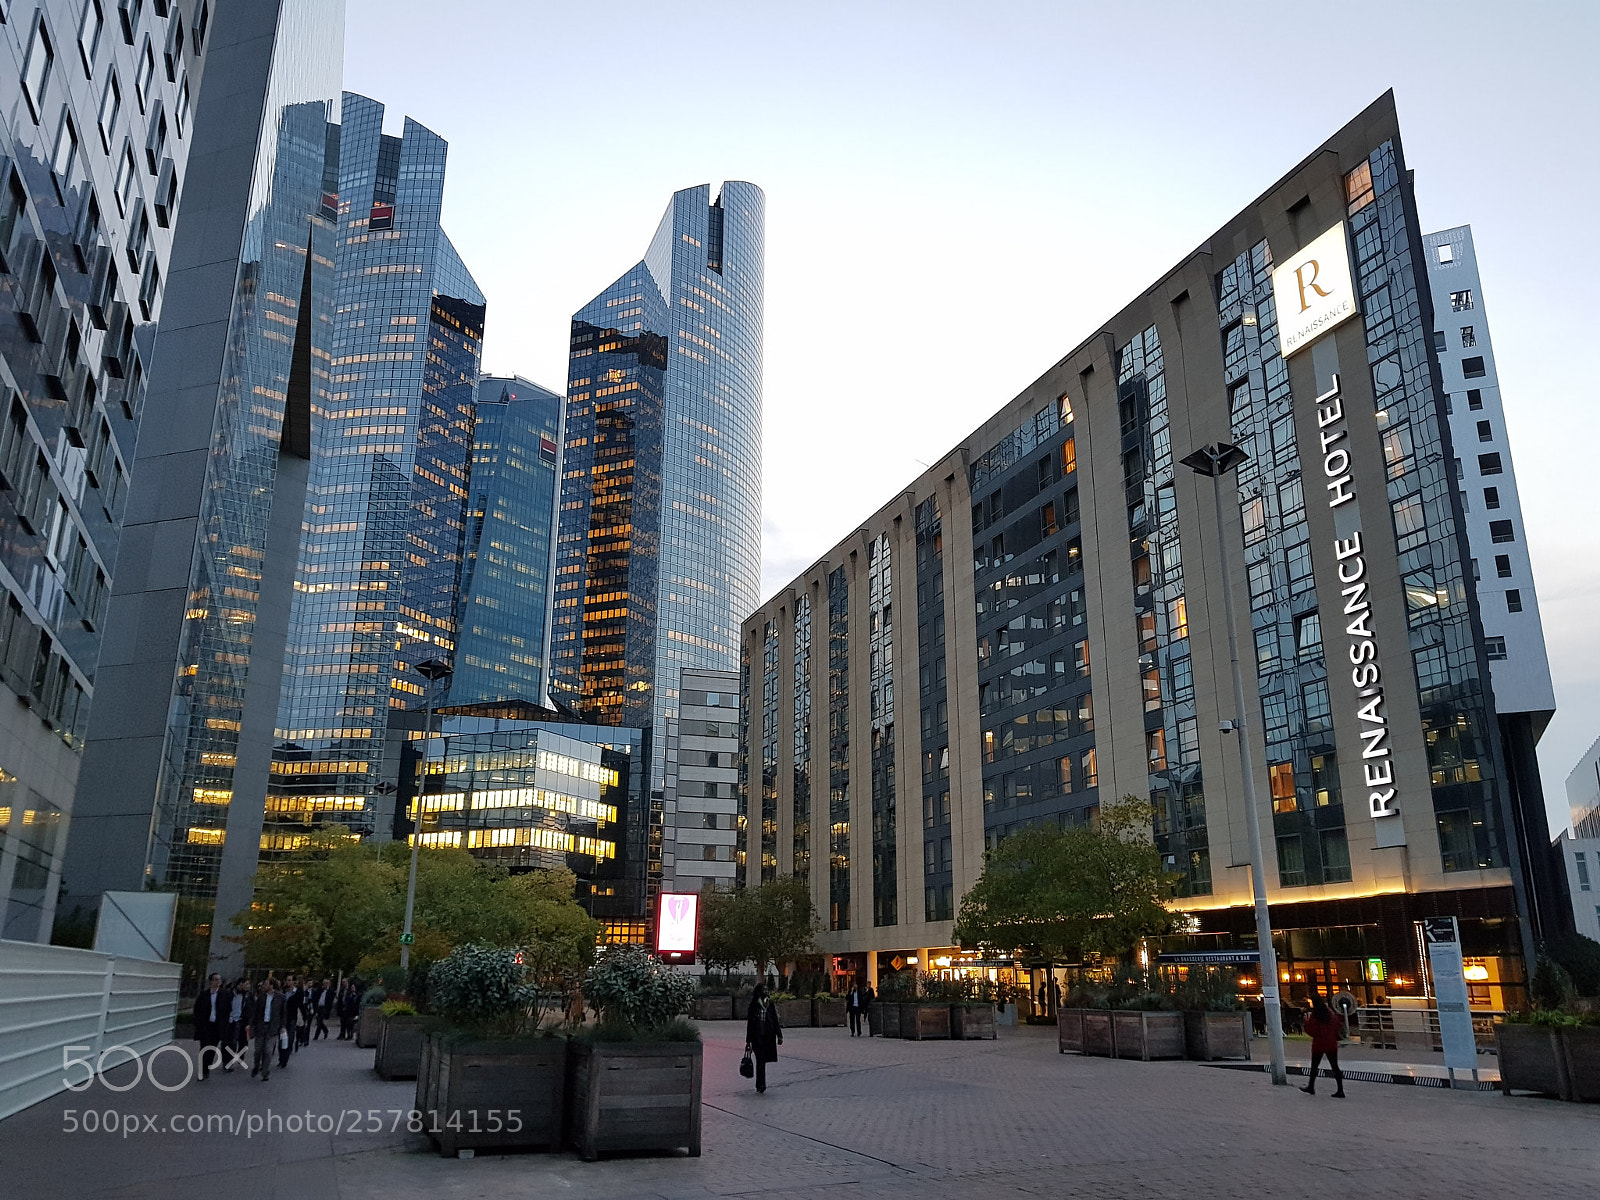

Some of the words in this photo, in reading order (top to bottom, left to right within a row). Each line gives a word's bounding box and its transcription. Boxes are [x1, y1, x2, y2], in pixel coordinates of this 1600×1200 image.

[1286, 300, 1349, 347] RENAISSANCE
[1293, 259, 1335, 315] R
[1316, 373, 1356, 508] HOTEL
[1335, 531, 1399, 818] RENAISSANCE
